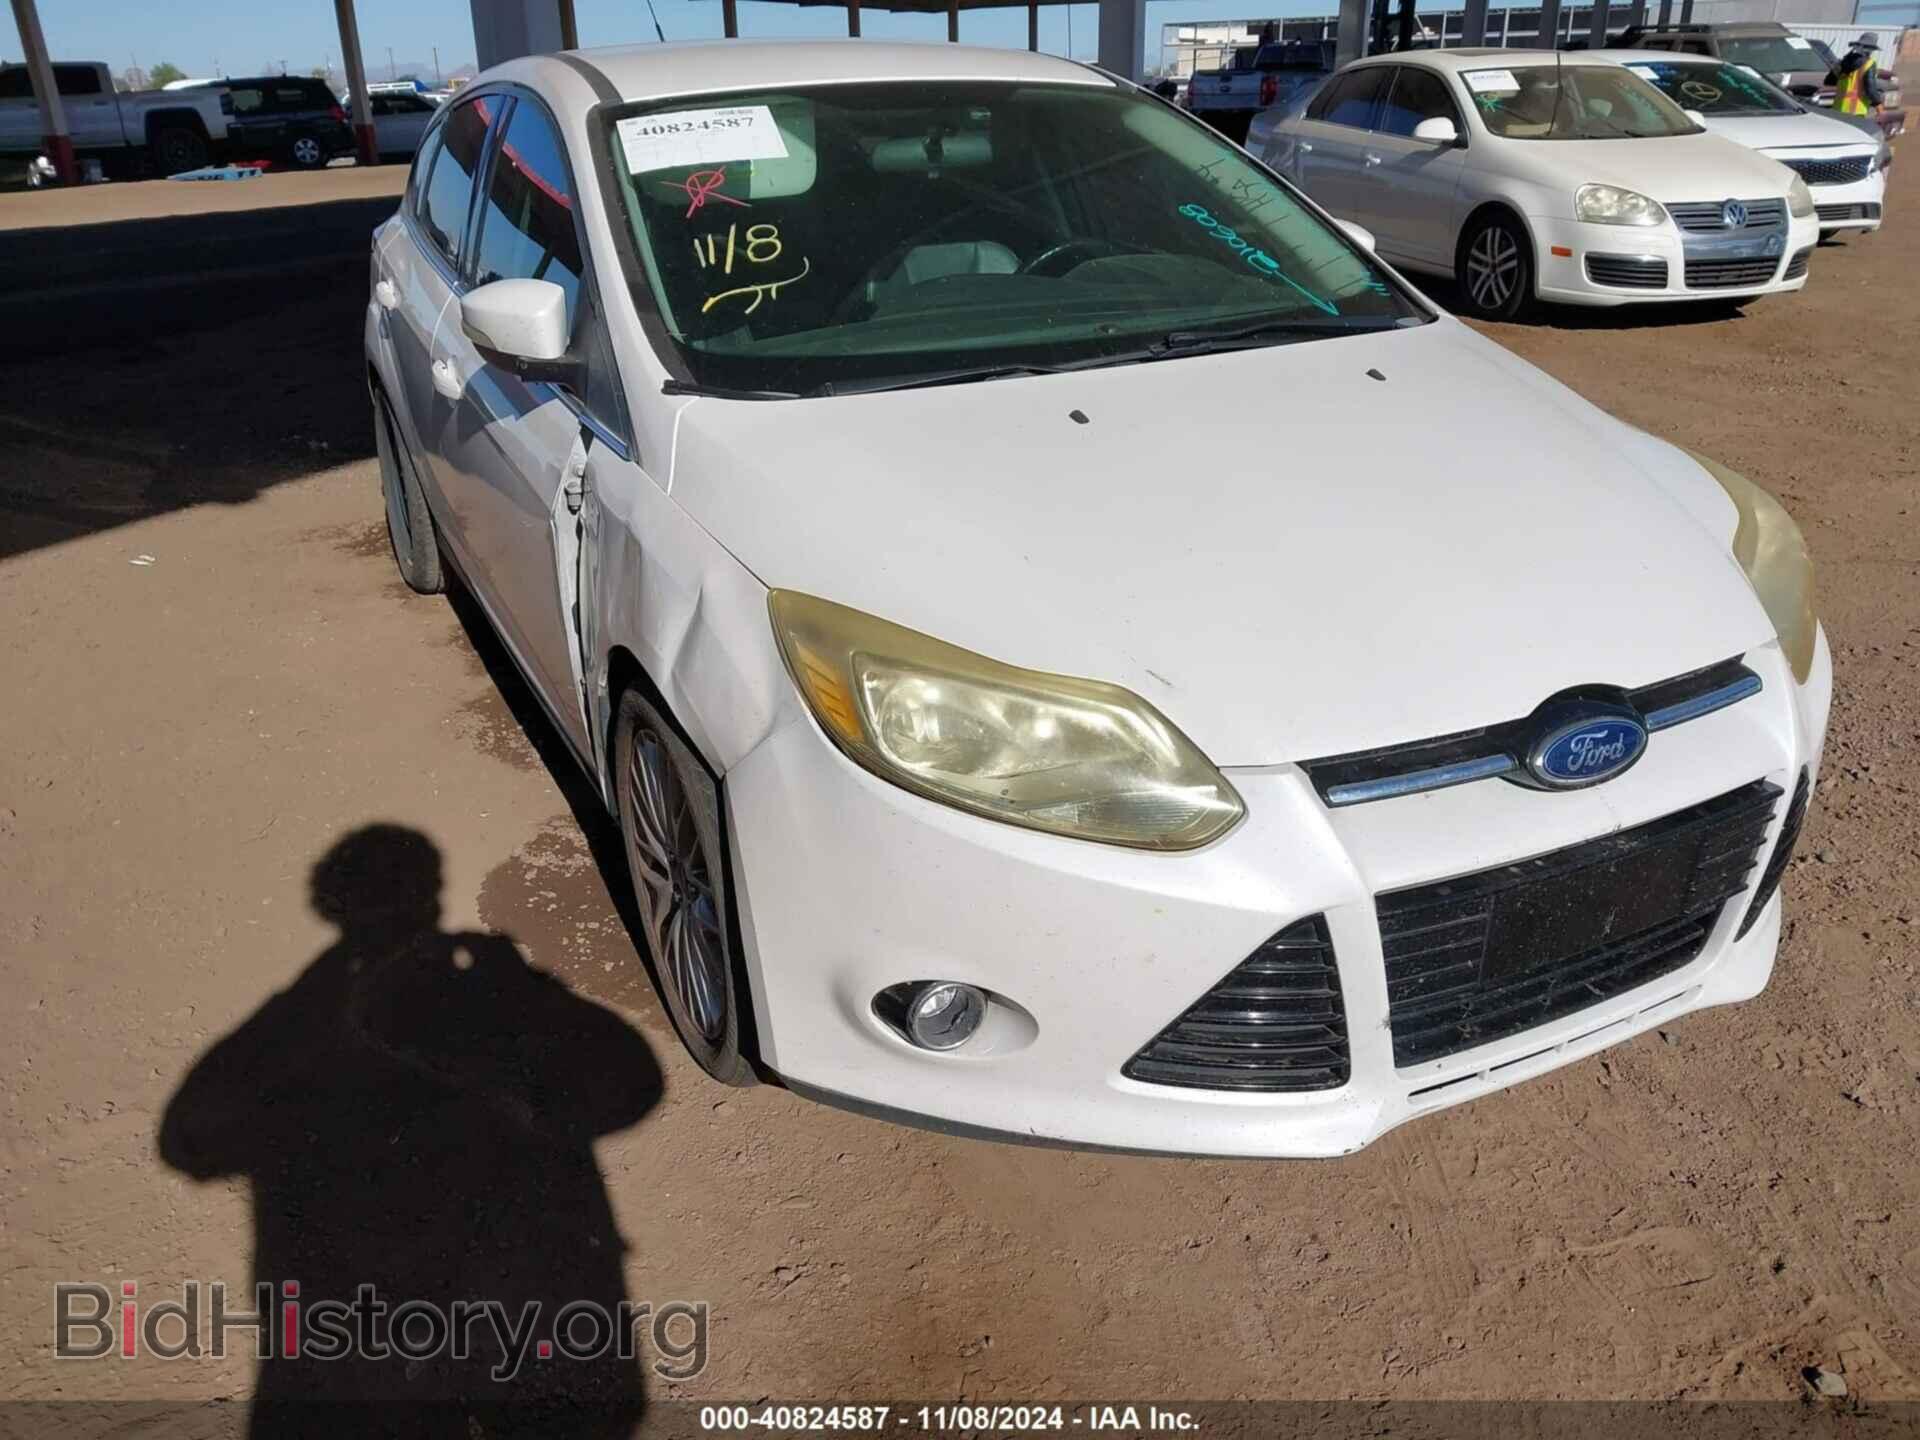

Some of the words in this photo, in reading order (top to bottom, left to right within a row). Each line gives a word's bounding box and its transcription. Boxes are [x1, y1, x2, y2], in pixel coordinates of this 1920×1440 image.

[636, 116, 754, 137] 40824587
[693, 222, 783, 275] 11/8
[1567, 730, 1625, 771] Ford
